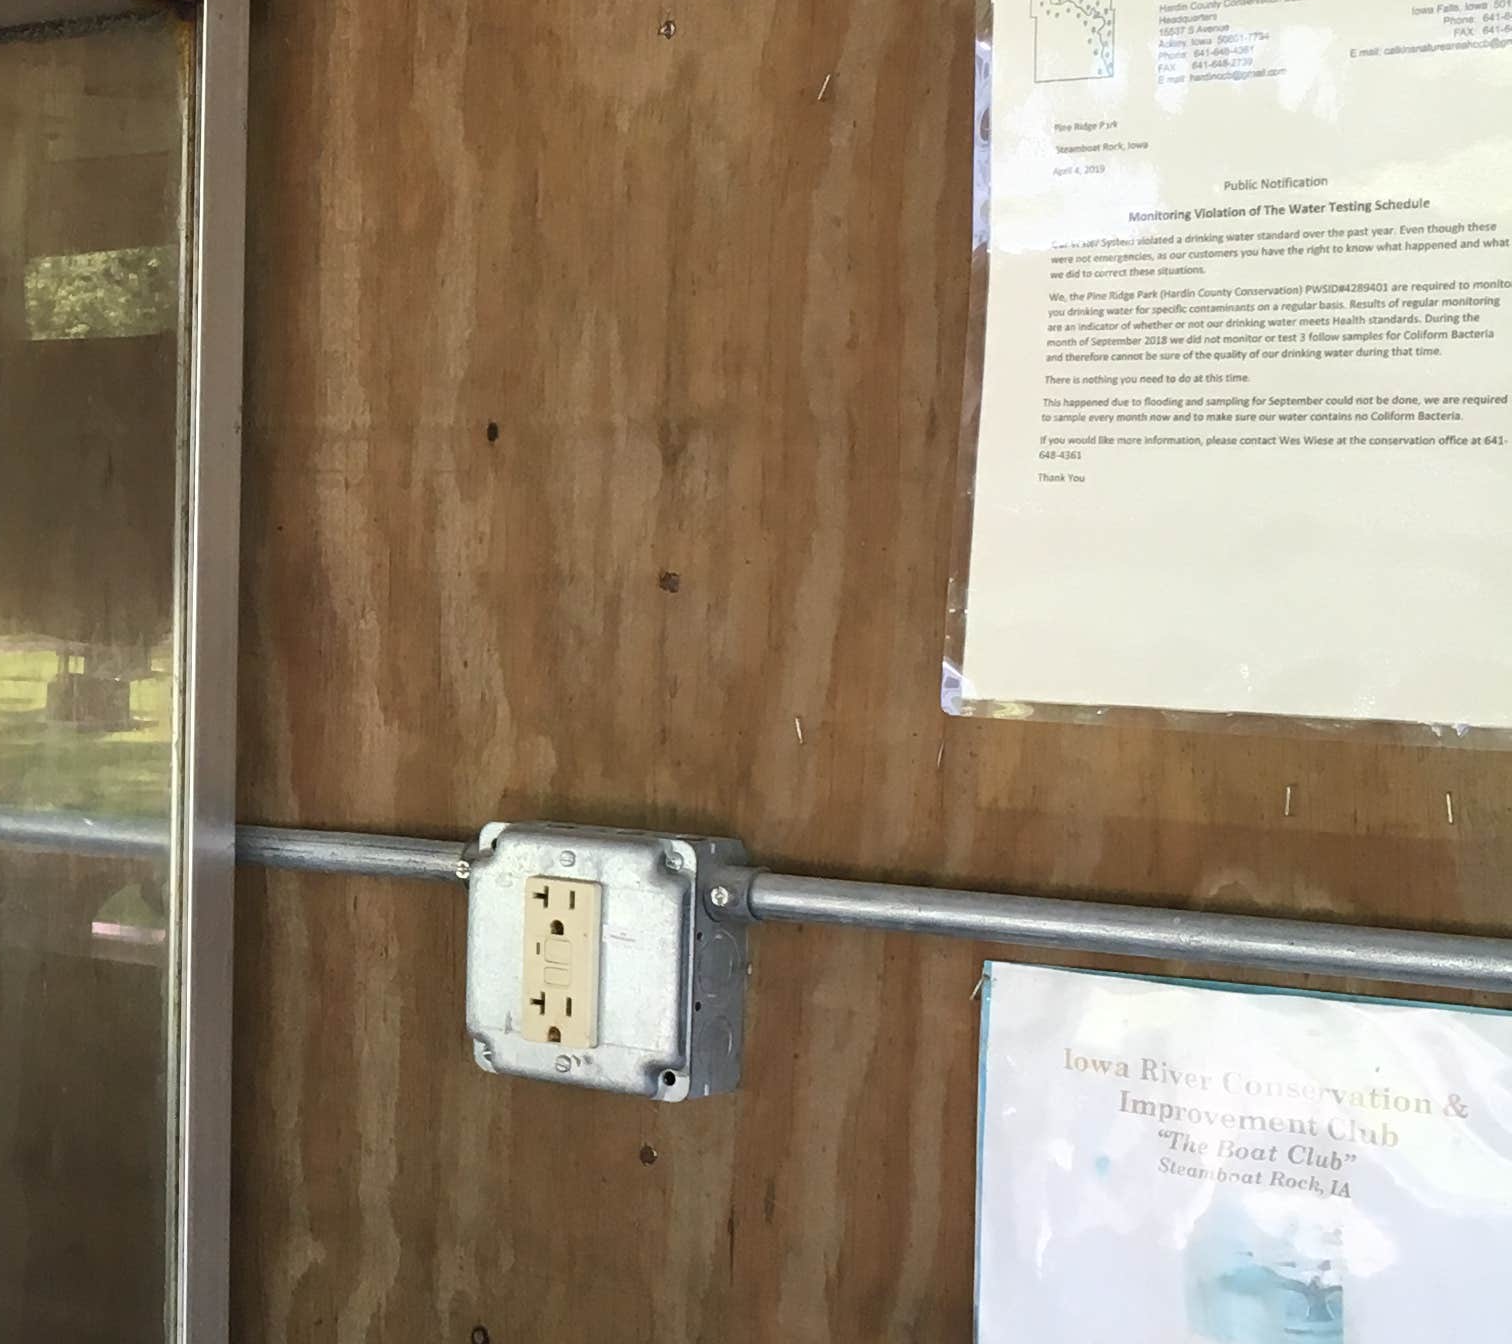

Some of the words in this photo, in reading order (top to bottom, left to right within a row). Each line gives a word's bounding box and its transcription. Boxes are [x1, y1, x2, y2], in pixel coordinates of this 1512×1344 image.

[1159, 3, 1188, 13] Hardin
[1190, 1, 1221, 12] County
[1074, 122, 1097, 133] Ridge
[1056, 143, 1101, 154] Steamboat
[1127, 140, 1149, 150] Iowa
[1084, 165, 1106, 175] 2019
[1224, 179, 1258, 191] Public
[1260, 176, 1329, 189] Notification
[1129, 210, 1191, 223] Monitoring
[1194, 207, 1246, 219] Violation
[1249, 206, 1262, 216] of
[1263, 205, 1286, 216] The
[1289, 203, 1326, 215] Water
[1329, 201, 1372, 213] Testing
[1375, 198, 1431, 210] Schedule
[1049, 293, 1067, 303] We,
[1069, 292, 1085, 302] the
[1087, 291, 1107, 301] Pine
[1109, 290, 1135, 303] Ridge
[1137, 289, 1158, 300] Park
[1160, 288, 1196, 301] (Hardin
[1198, 287, 1232, 300] County
[1235, 285, 1303, 297] Conservation)
[1305, 282, 1388, 295] PWSID#4289401
[1391, 283, 1408, 292] are
[1411, 280, 1456, 293] required
[1458, 281, 1470, 290] to
[1473, 279, 1512, 289] monito
[1047, 337, 1077, 347] month
[1079, 336, 1089, 347] of
[1091, 335, 1142, 349] September
[1144, 335, 1167, 345] 2018
[1170, 336, 1185, 345] we
[1186, 334, 1202, 344] did
[1204, 335, 1220, 344] not
[1223, 334, 1262, 344] monitor
[1265, 335, 1276, 343] or
[1278, 333, 1297, 343] test
[1299, 333, 1306, 342] 3
[1308, 331, 1339, 343] follow
[1342, 331, 1383, 344] samples
[1385, 330, 1401, 341] for
[1404, 329, 1448, 340] Coliform
[1451, 329, 1495, 339] Bacteria
[1043, 398, 1061, 407] This
[1063, 398, 1109, 409] happened
[1111, 397, 1129, 407] due
[1132, 398, 1142, 407] to
[1144, 397, 1184, 409] flooding
[1185, 397, 1204, 407] and
[1206, 397, 1250, 409] sampling
[1252, 397, 1267, 407] for
[1268, 396, 1323, 407] September
[1325, 396, 1354, 406] could
[1356, 396, 1373, 406] not
[1376, 395, 1389, 405] be
[1391, 395, 1421, 406] done,
[1424, 396, 1440, 405] we
[1442, 396, 1460, 405] are
[1462, 395, 1508, 407] required
[1038, 451, 1082, 461] 648-4361
[1037, 473, 1066, 483] Thank
[1068, 473, 1086, 483] You
[1064, 1047, 1129, 1078] Iowa
[1140, 1058, 1212, 1091] River
[1222, 1072, 1433, 1115] Conservation
[1443, 1093, 1469, 1119] &
[1119, 1090, 1319, 1138] Improvement
[1328, 1117, 1401, 1148] Club
[1217, 1139, 1278, 1162] Boat
[1157, 1157, 1263, 1185] Steamboat
[1269, 1170, 1325, 1196] Rock,
[1330, 1180, 1352, 1199] IA
